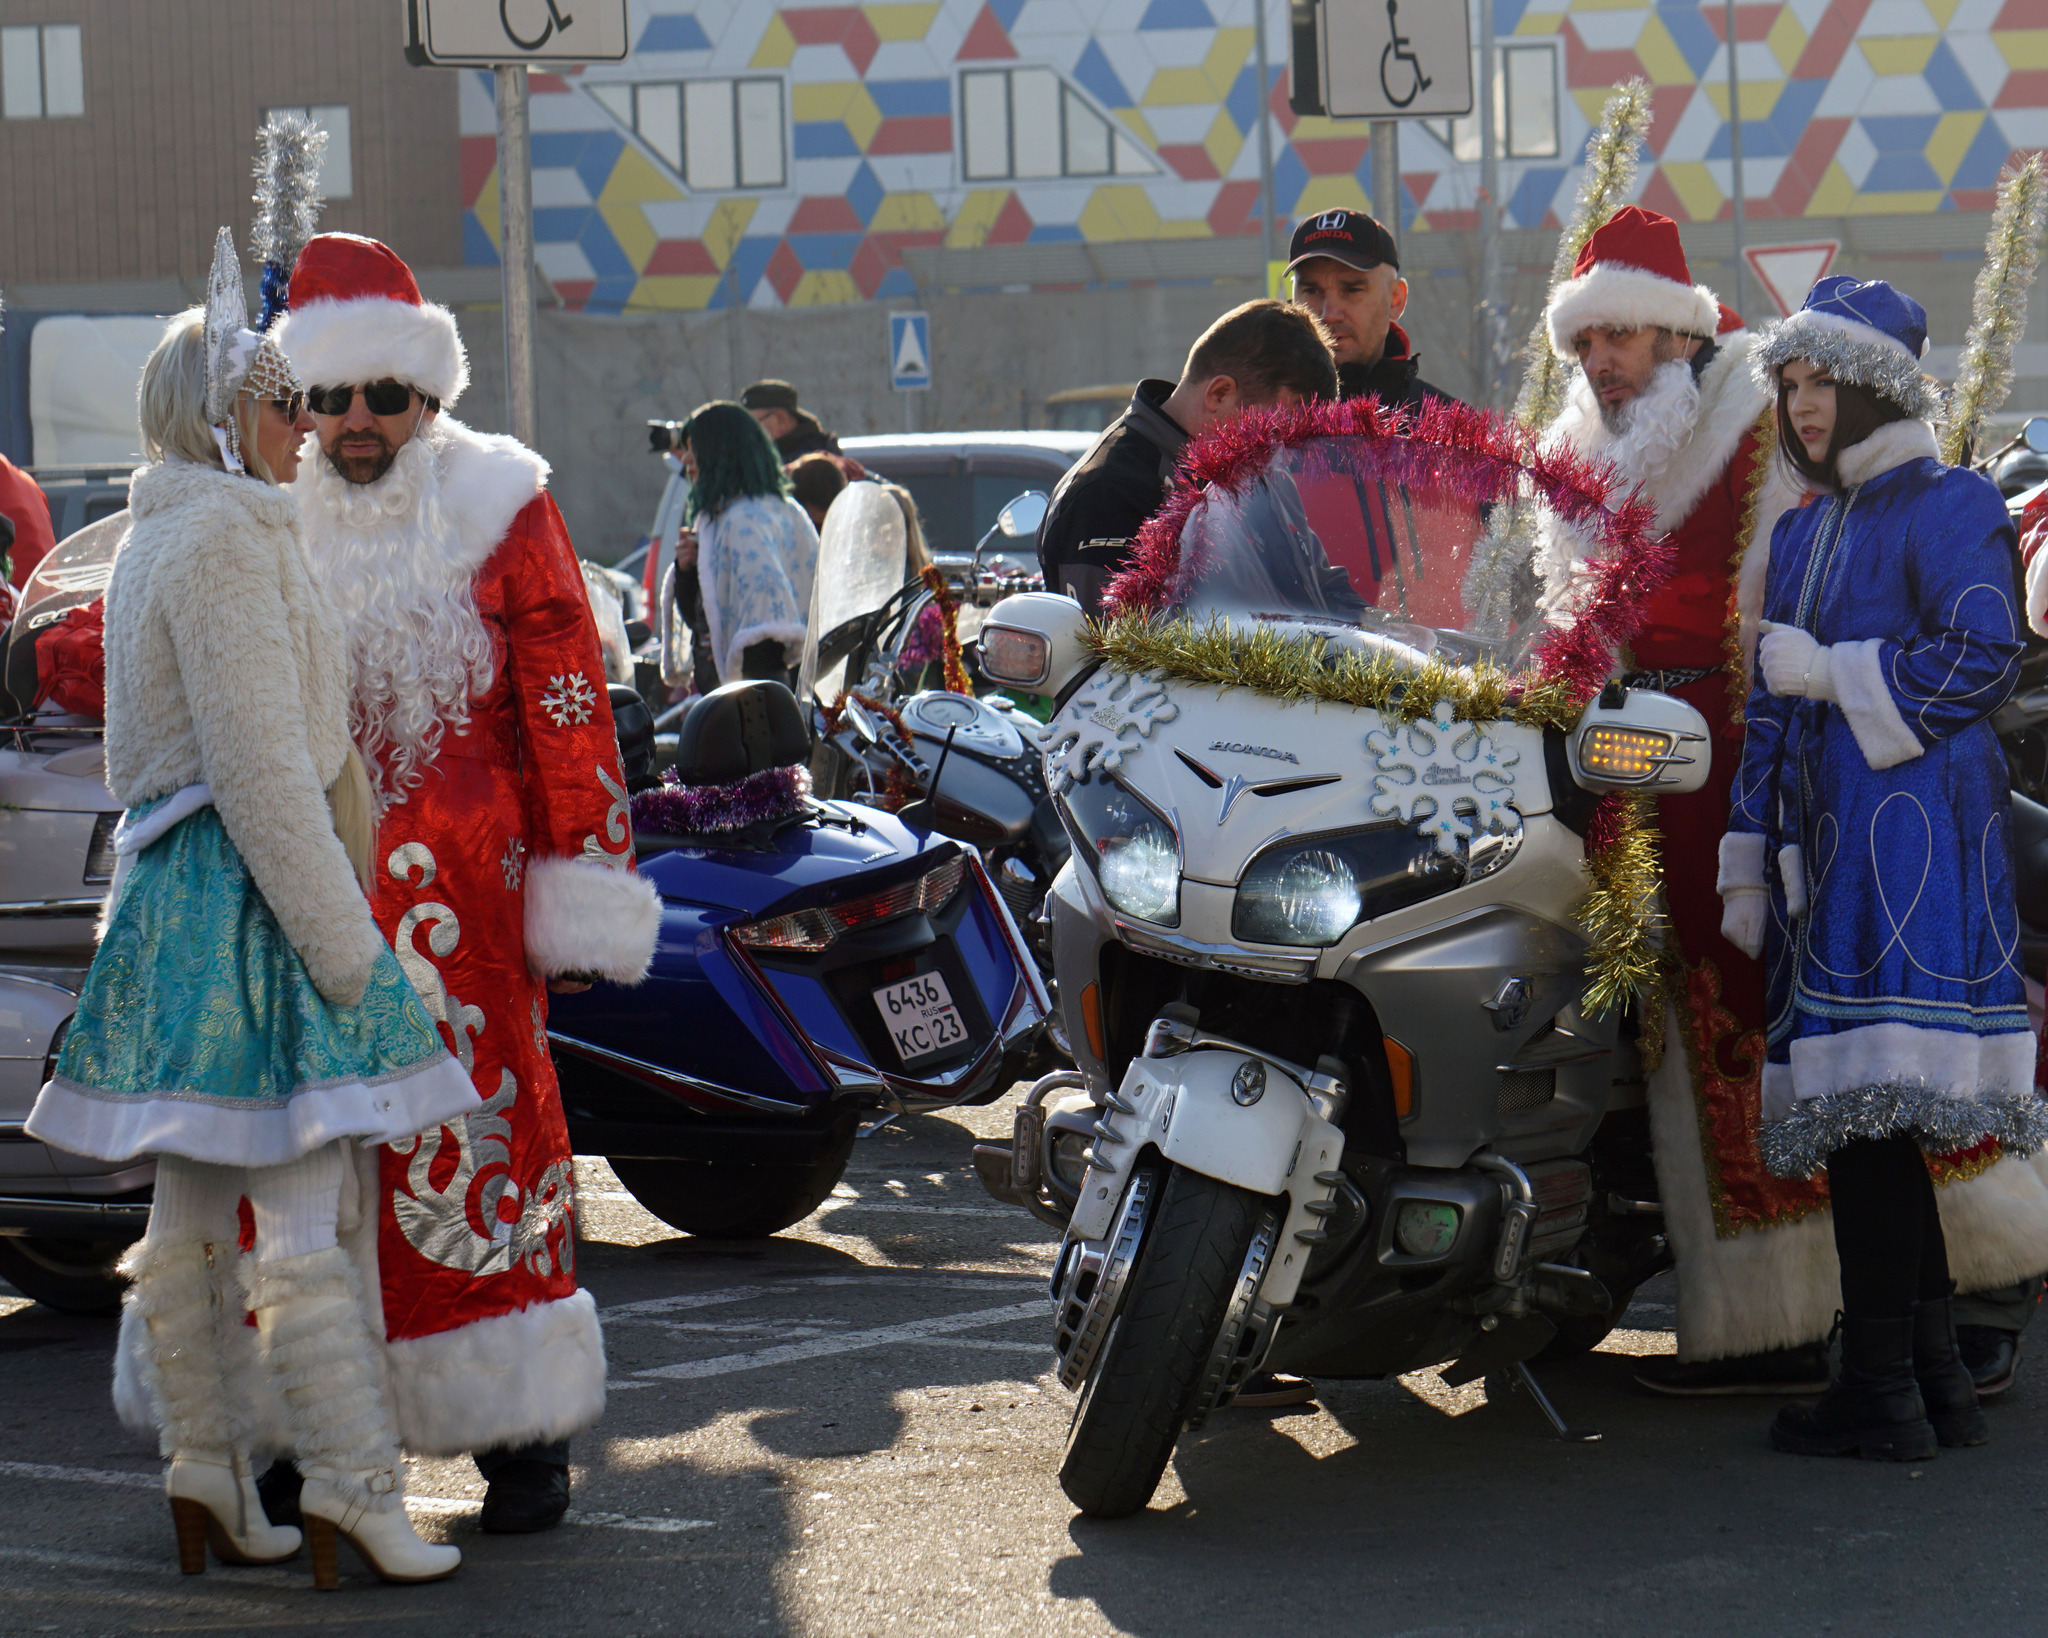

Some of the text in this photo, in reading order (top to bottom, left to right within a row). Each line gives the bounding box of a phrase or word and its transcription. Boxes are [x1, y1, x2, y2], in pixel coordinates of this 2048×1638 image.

[1303, 229, 1354, 244] HONDA
[1077, 537, 1127, 551] LS2
[1208, 740, 1300, 765] HONDA
[886, 977, 939, 1015] 6436
[920, 1006, 938, 1018] RUS
[932, 1013, 961, 1043] 23
